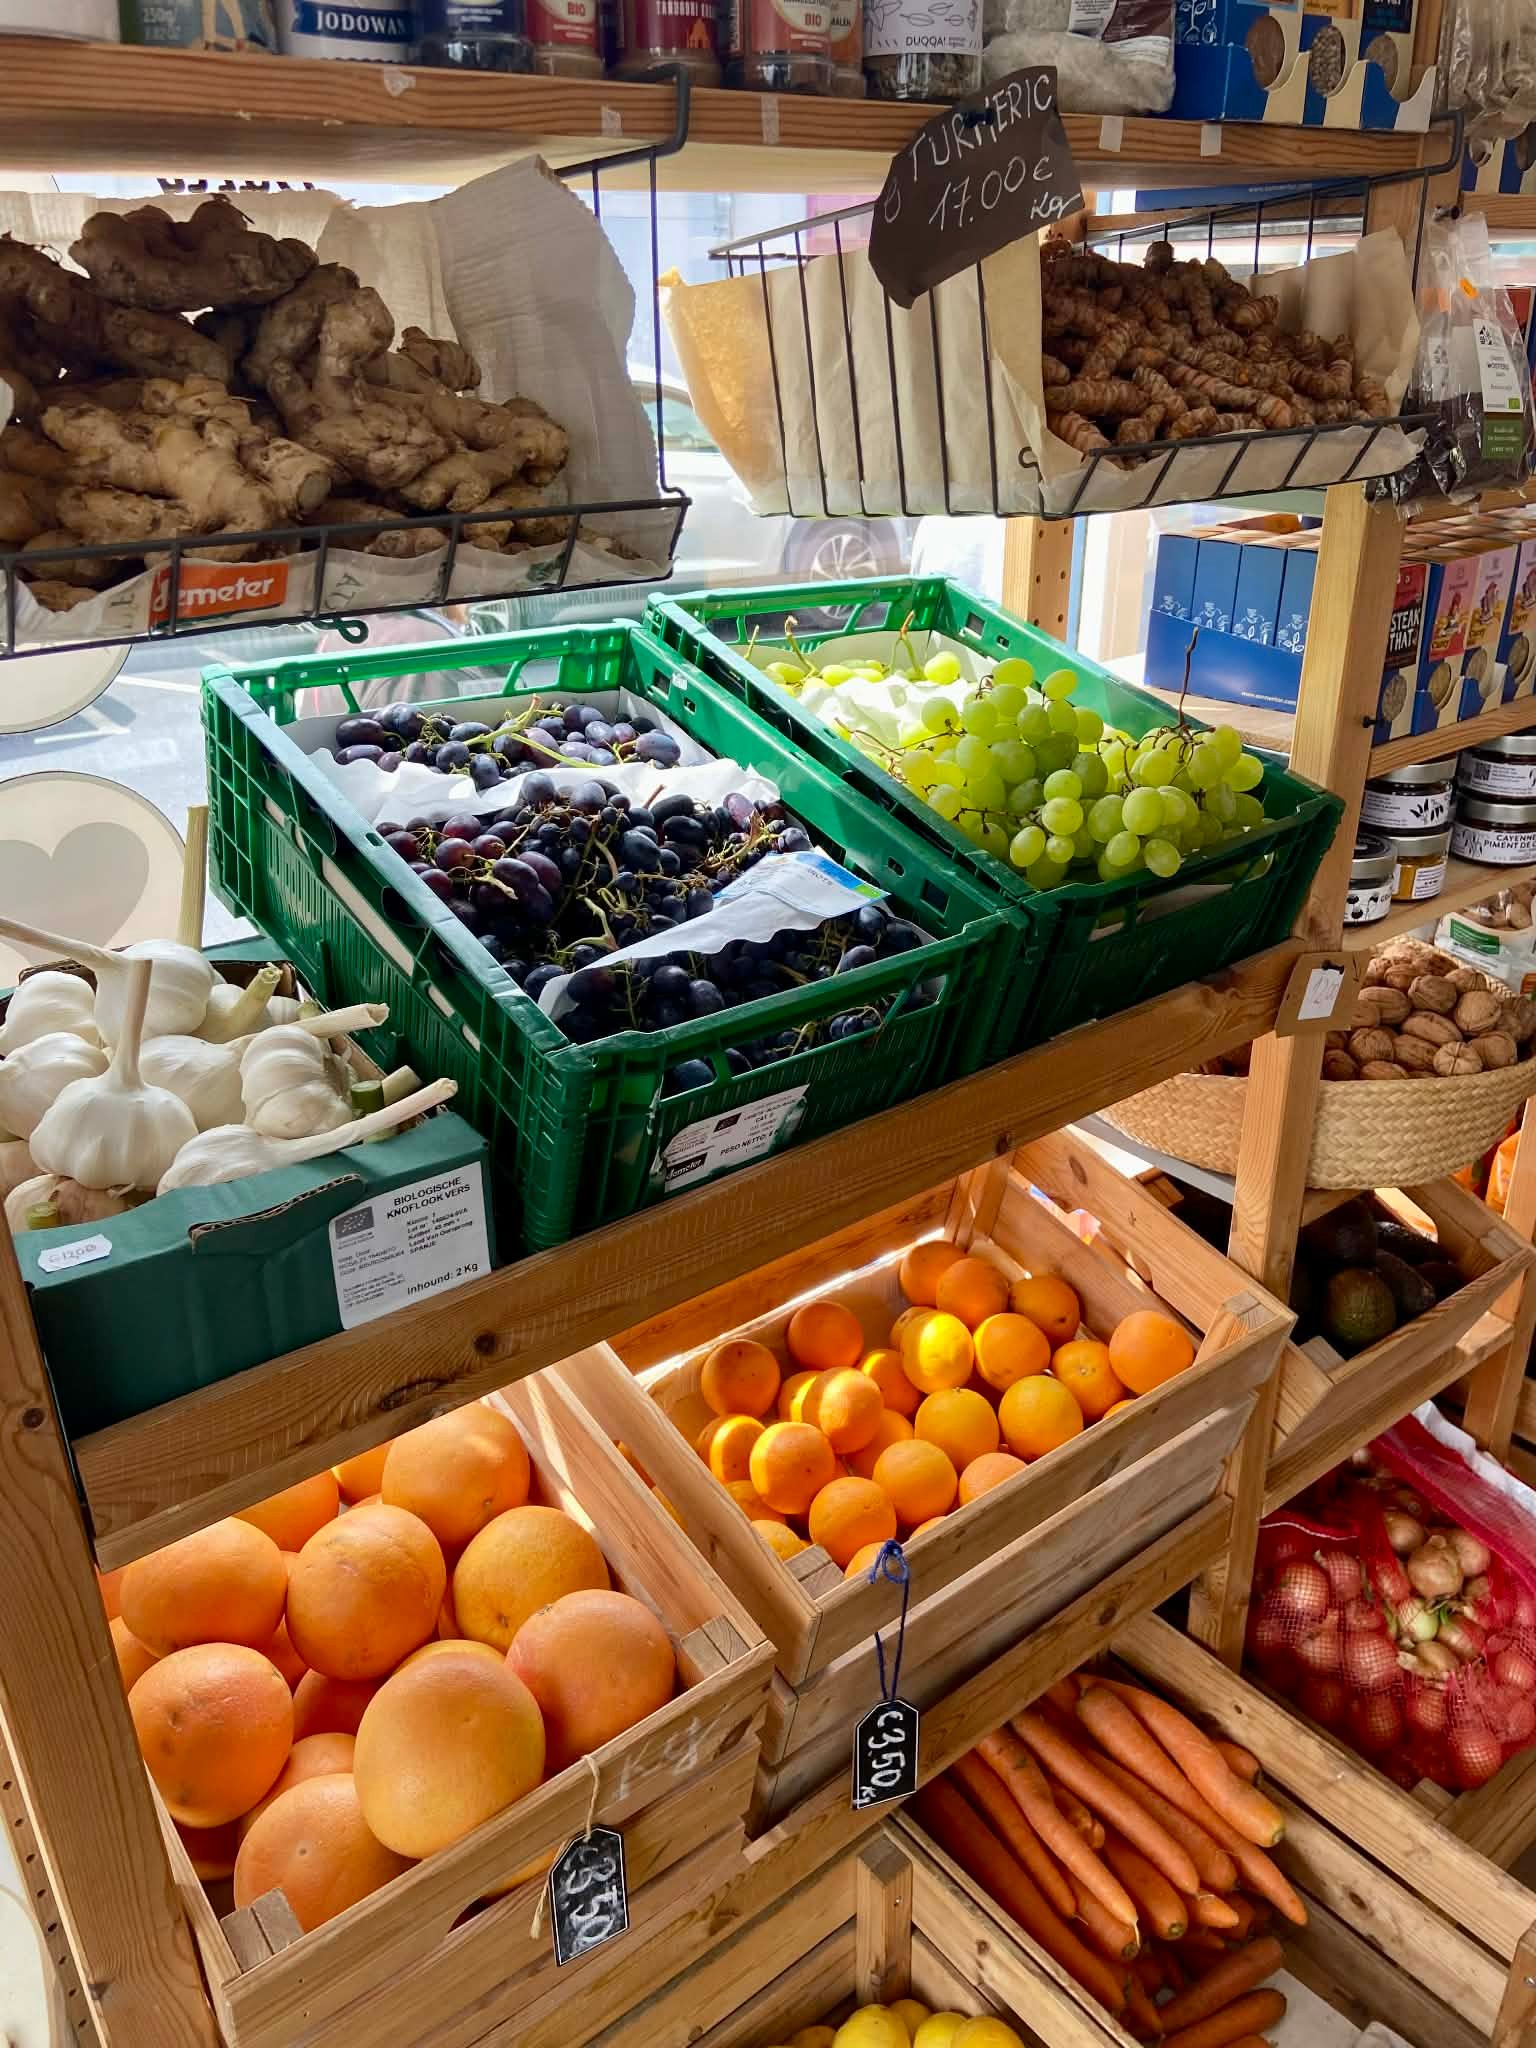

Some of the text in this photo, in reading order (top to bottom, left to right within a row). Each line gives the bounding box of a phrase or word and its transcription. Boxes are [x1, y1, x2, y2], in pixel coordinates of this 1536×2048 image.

[567, 2, 586, 17] BIO
[908, 73, 1053, 182] TURMERIC
[1391, 608, 1421, 633] STEAK
[1389, 628, 1414, 653] THAT
[386, 1194, 444, 1220] KNOFLOOK
[444, 1184, 471, 1202] VERS
[393, 1176, 462, 1207] BIOLOGISCHE
[455, 1267, 463, 1277] 2
[464, 1262, 479, 1274] Kg
